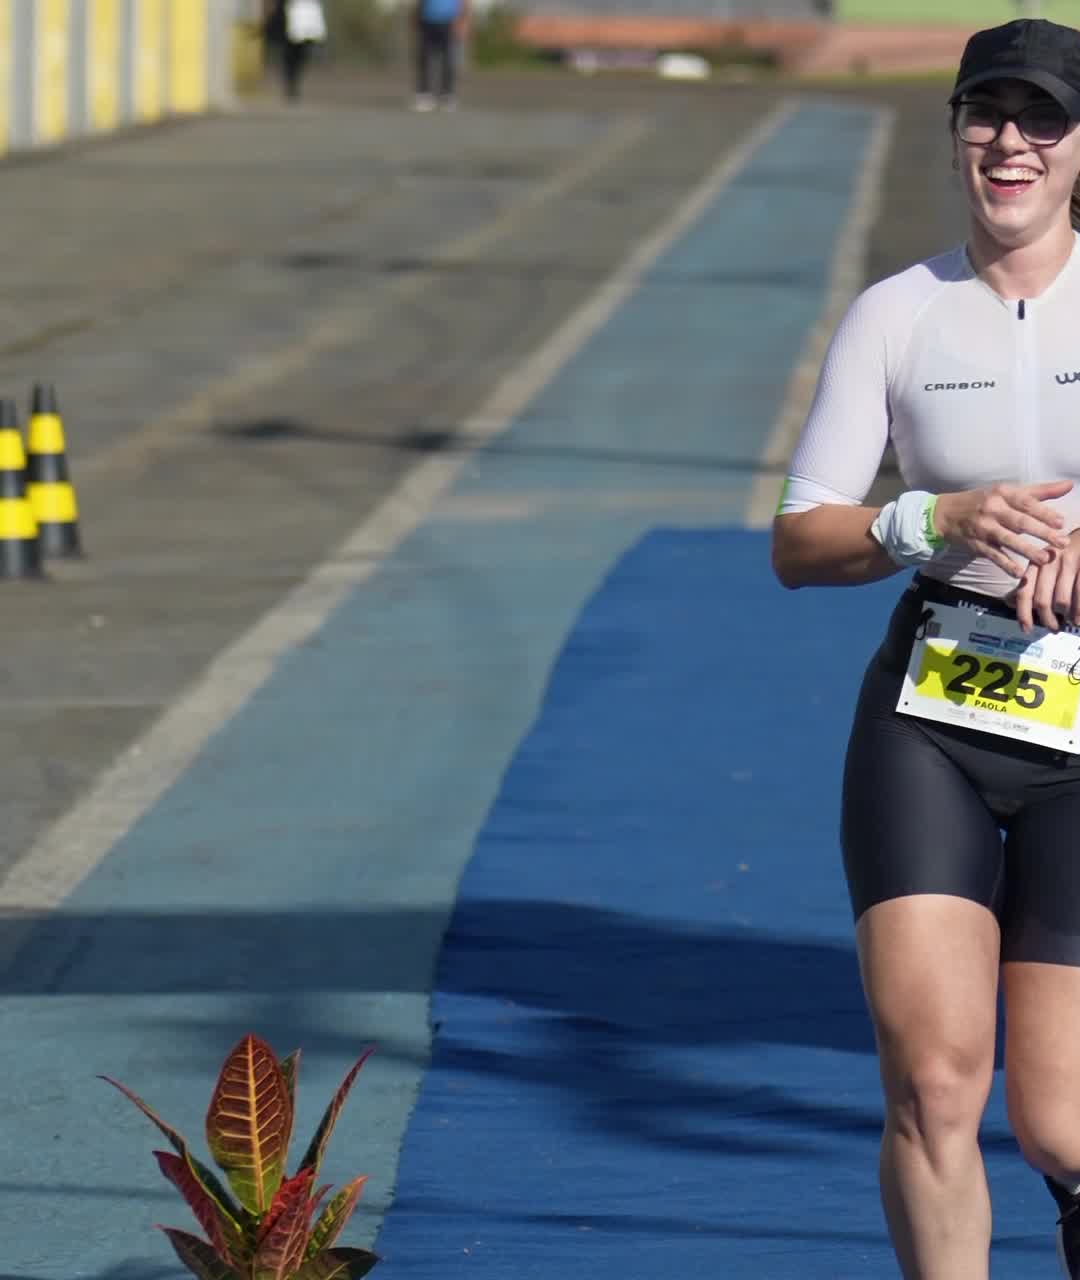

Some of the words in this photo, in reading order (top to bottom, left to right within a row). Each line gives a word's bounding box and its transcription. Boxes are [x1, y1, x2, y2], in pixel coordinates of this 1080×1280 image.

[924, 380, 996, 392] CARBON
[946, 653, 1049, 709] 225
[974, 699, 1008, 714] PAOLA
